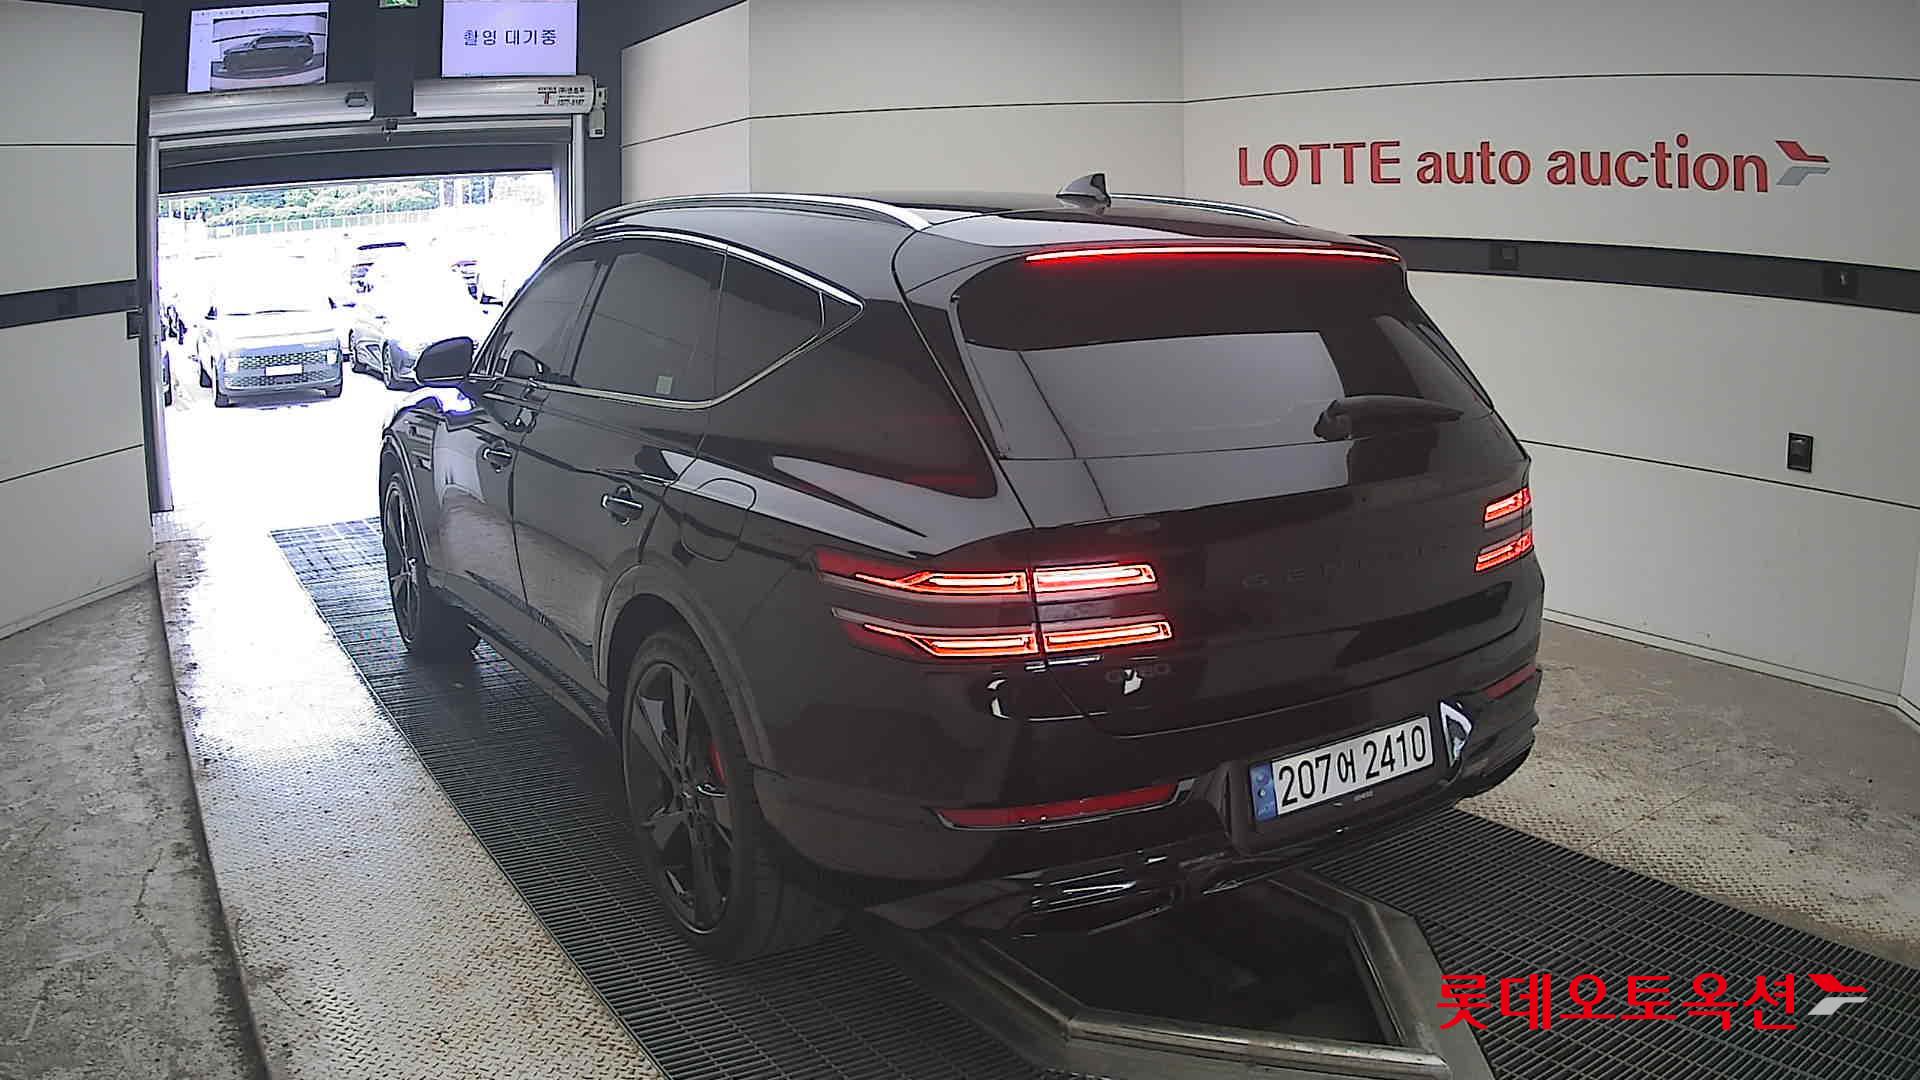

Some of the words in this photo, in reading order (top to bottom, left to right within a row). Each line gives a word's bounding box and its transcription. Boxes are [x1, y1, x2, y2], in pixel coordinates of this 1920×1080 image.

[505, 29, 557, 46] 대기중
[1238, 141, 1400, 187] LOTTE
[1417, 141, 1531, 185] auto
[1547, 134, 1768, 193] auction
[1278, 749, 1357, 808] 207어
[1363, 725, 1427, 780] 2410
